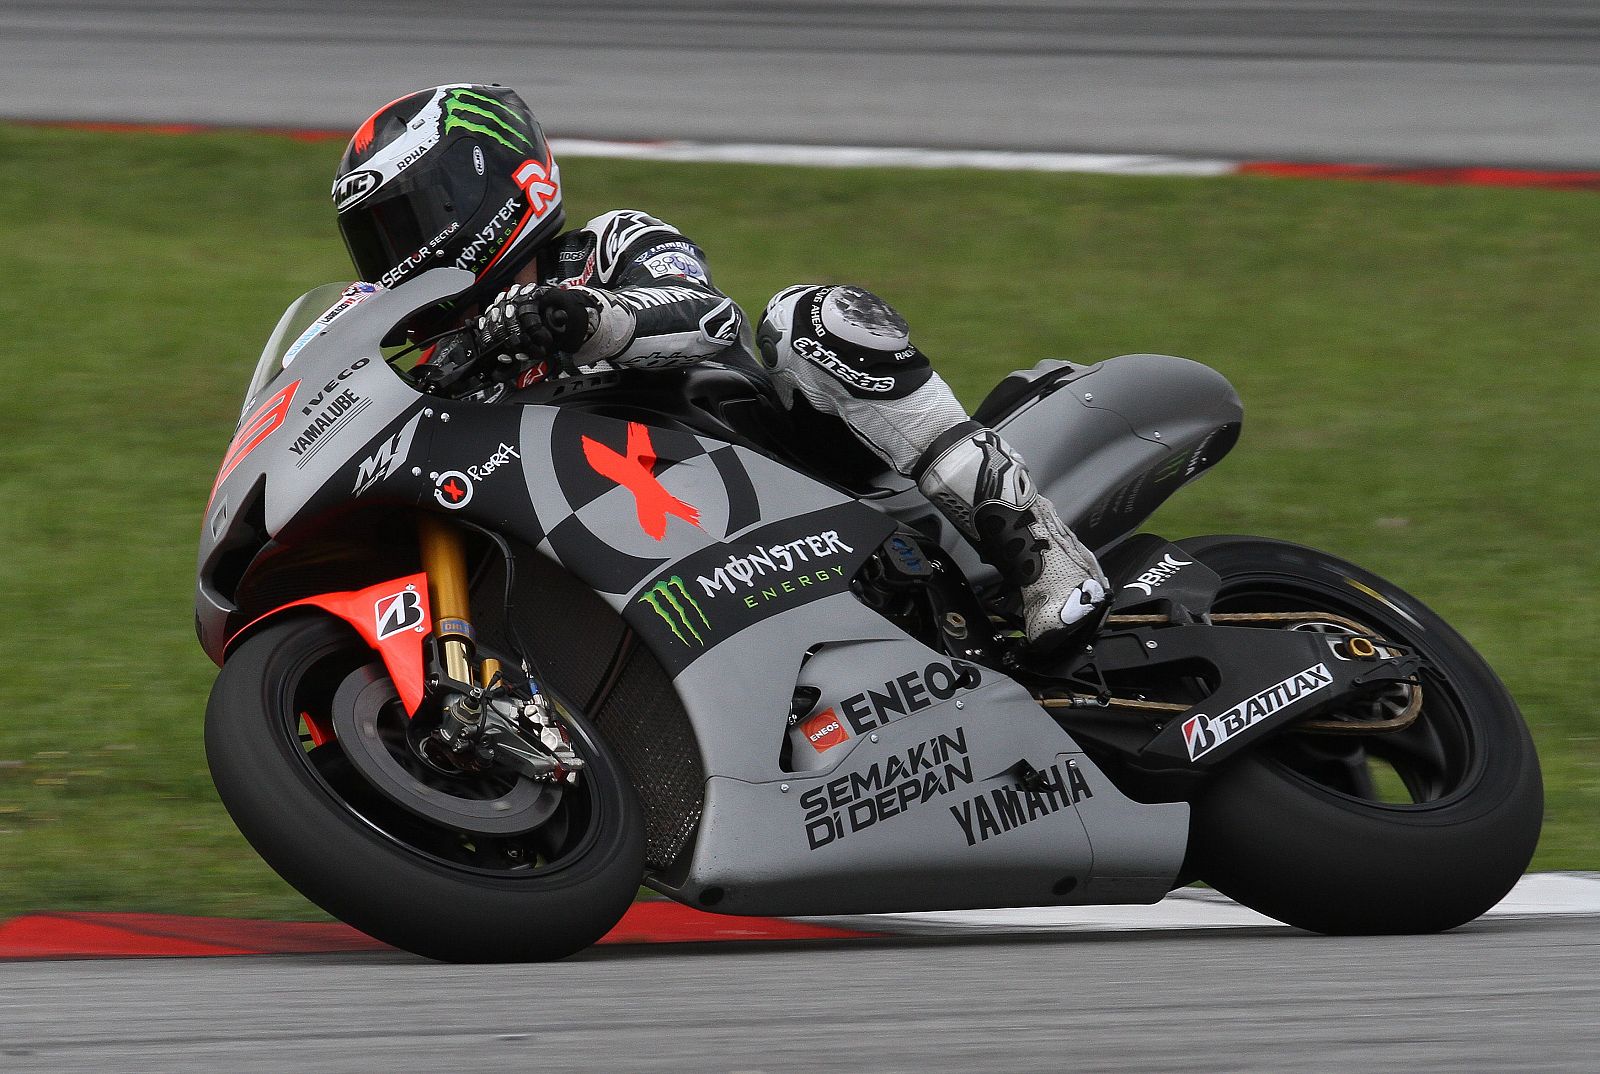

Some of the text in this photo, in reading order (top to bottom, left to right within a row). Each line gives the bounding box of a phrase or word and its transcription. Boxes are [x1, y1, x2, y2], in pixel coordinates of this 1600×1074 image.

[396, 145, 428, 170] RPHA
[471, 219, 518, 273] ENERGY
[811, 304, 826, 338] AHEAD
[302, 357, 370, 416] IVECO
[288, 388, 361, 456] YAMALUBE
[696, 529, 854, 598] MONSTER
[743, 565, 845, 609] ENERGY
[809, 660, 982, 743] ENEOS ENEOS
[1219, 665, 1330, 738] BATTLAX
[848, 756, 974, 833] DEPAN
[949, 759, 1094, 847] YAMAHA
